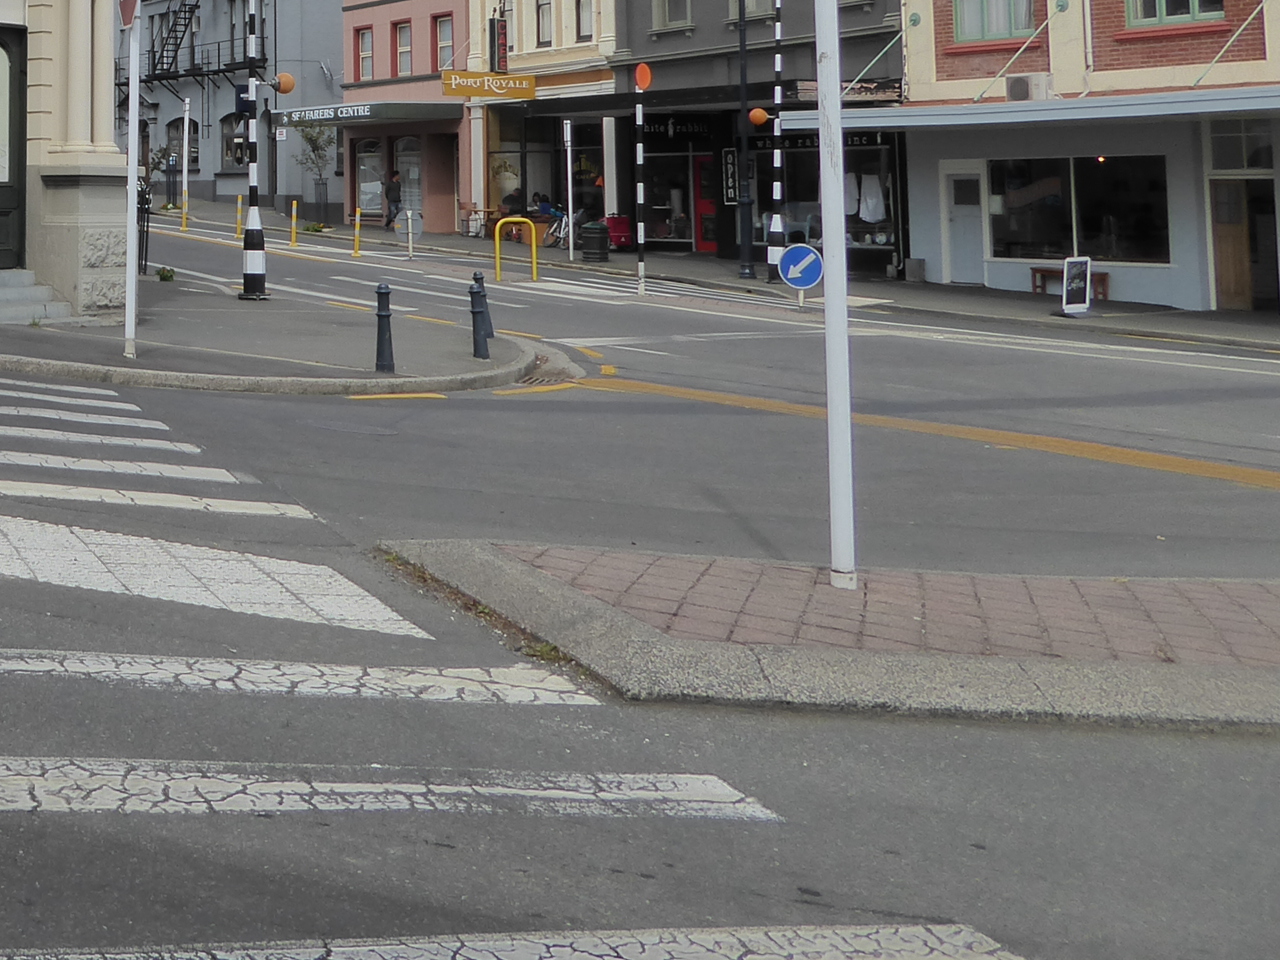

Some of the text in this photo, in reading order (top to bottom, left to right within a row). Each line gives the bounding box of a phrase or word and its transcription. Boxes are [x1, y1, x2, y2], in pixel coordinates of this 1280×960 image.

[497, 21, 507, 70] CAFE
[291, 105, 371, 121] SEAFARERS CENTRE
[642, 123, 665, 132] hite
[847, 136, 867, 145] inc
